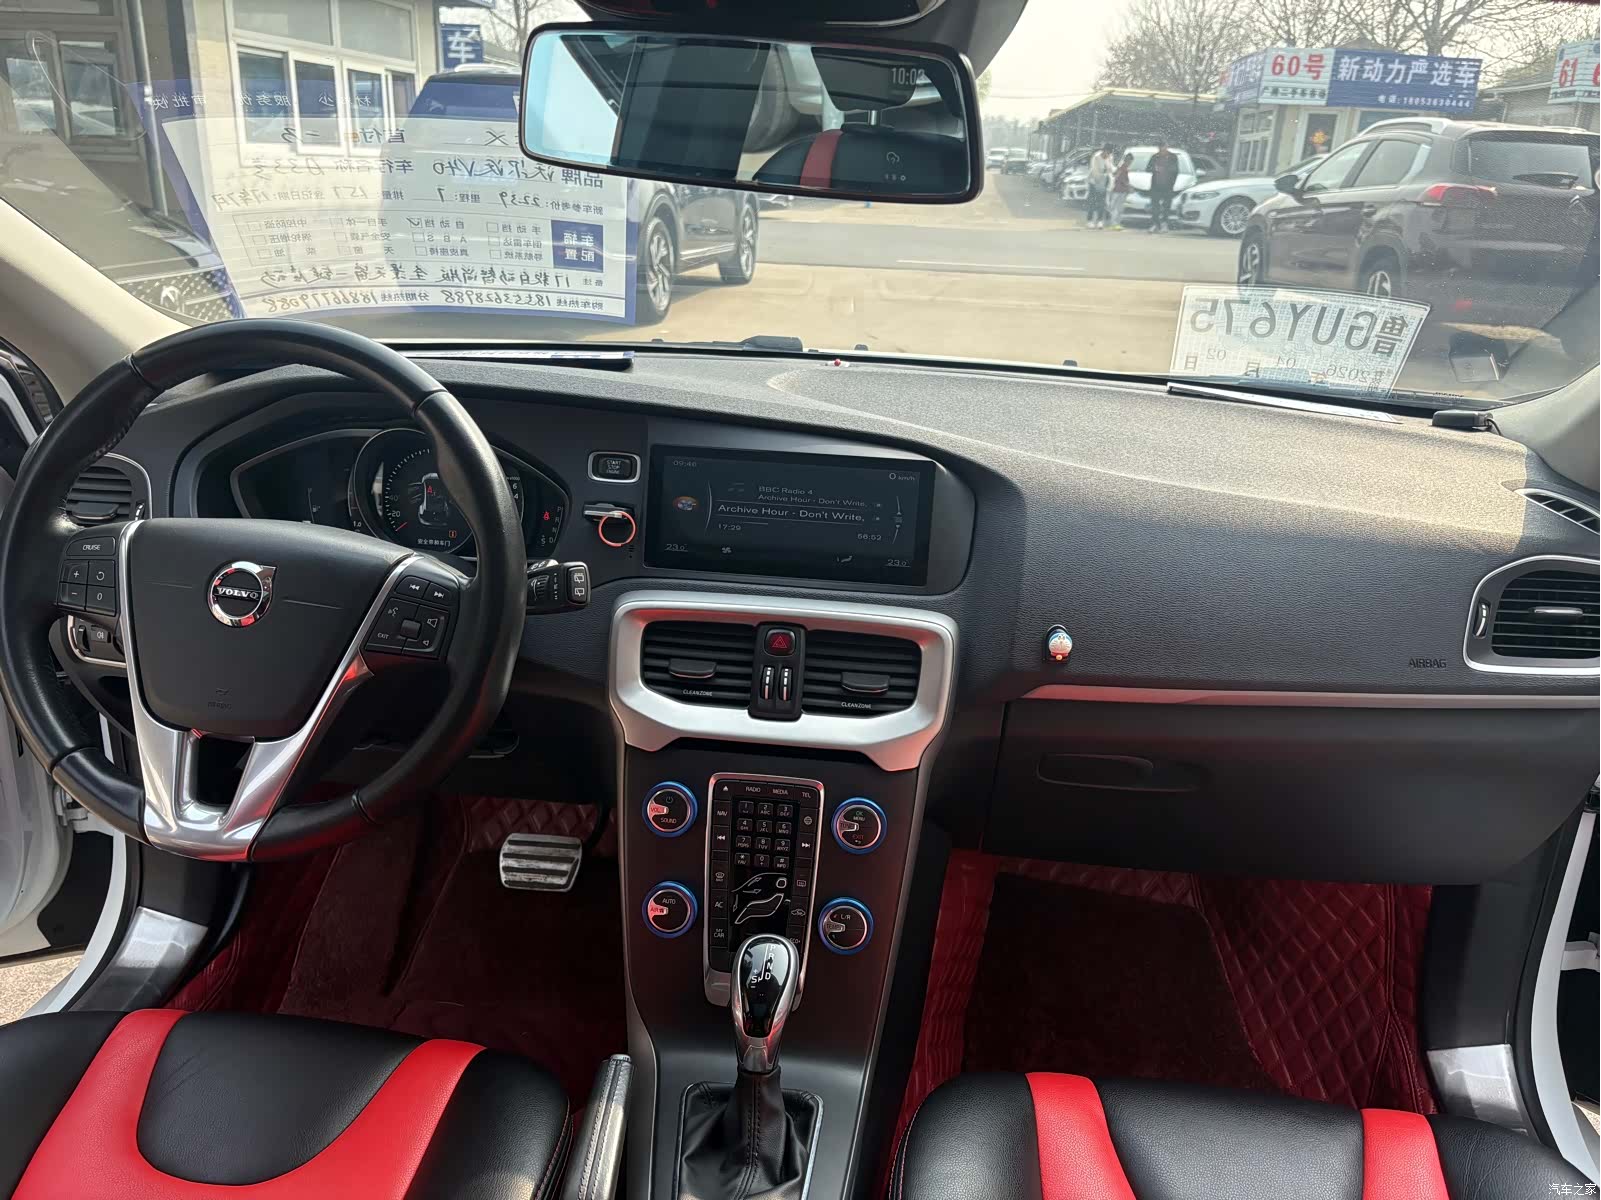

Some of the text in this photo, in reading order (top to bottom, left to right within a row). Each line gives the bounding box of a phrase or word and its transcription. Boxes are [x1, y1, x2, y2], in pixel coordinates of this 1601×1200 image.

[448, 27, 480, 64] 车
[1271, 54, 1325, 80] 60号
[1337, 56, 1480, 88] 新动力严选车
[1559, 58, 1578, 87] 61
[781, 487, 806, 495] Radio
[718, 504, 758, 515] Archive
[761, 507, 789, 517] Hour
[799, 508, 828, 520] Don't
[216, 587, 260, 600] VOLVO
[1409, 658, 1447, 669] AIRBAG
[682, 689, 713, 697] CLEANZONE
[841, 701, 872, 709] CLEANZONE
[662, 897, 677, 905] AUTO
[714, 901, 725, 909] AC
